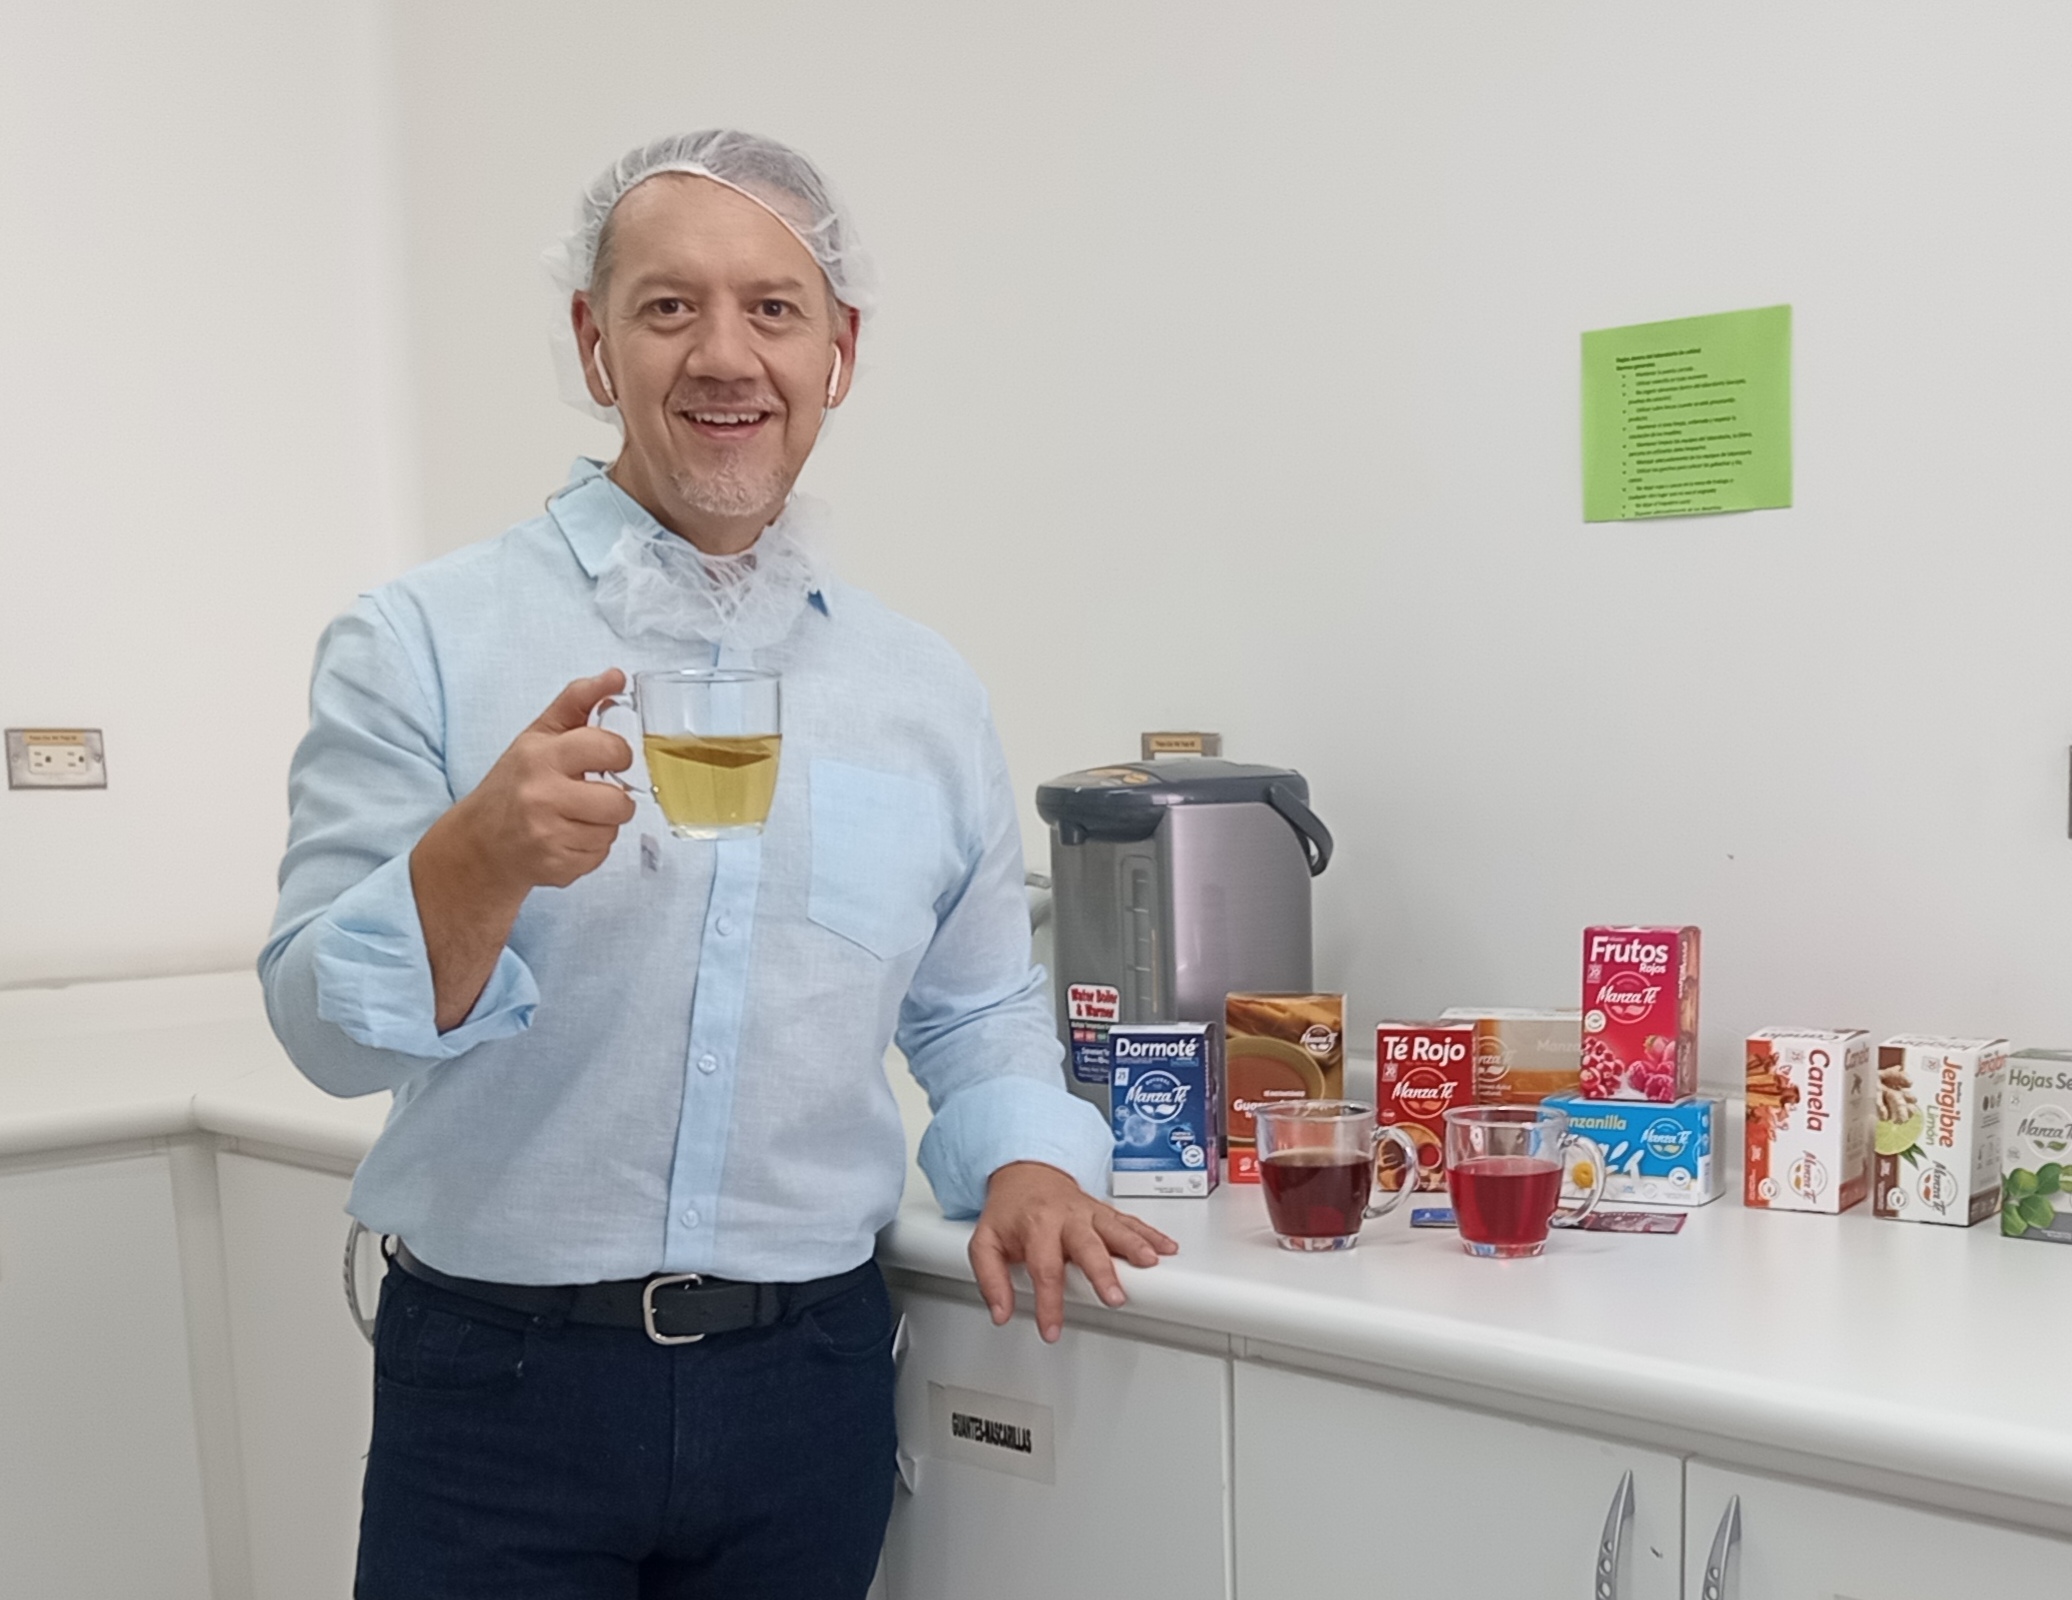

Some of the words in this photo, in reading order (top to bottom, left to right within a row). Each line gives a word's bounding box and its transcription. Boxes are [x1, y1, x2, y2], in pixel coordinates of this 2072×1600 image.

[1590, 936, 1669, 963] Frutos
[1639, 963, 1667, 976] Rojos
[1595, 985, 1642, 1004] Manza
[1115, 1037, 1197, 1057] Dormoté
[1383, 1036, 1409, 1060] Té
[1412, 1036, 1466, 1067] Rojo
[1391, 1081, 1440, 1100] Manza
[1438, 1081, 1459, 1099] Té
[1806, 1048, 1830, 1132] Canela
[2008, 1068, 2053, 1092] Hojas
[2055, 1072, 2072, 1091] Se
[1125, 1085, 1173, 1104] Manza
[1172, 1085, 1192, 1103] Té
[1935, 1056, 1963, 1148] Jengibre
[1569, 1114, 1627, 1131] nzanilla
[1925, 1105, 1939, 1146] Limón
[2017, 1118, 2064, 1138] Manza
[1640, 1128, 1678, 1143] Manza
[1802, 1150, 1817, 1189] Manza
[1932, 1160, 1947, 1201] Manza
